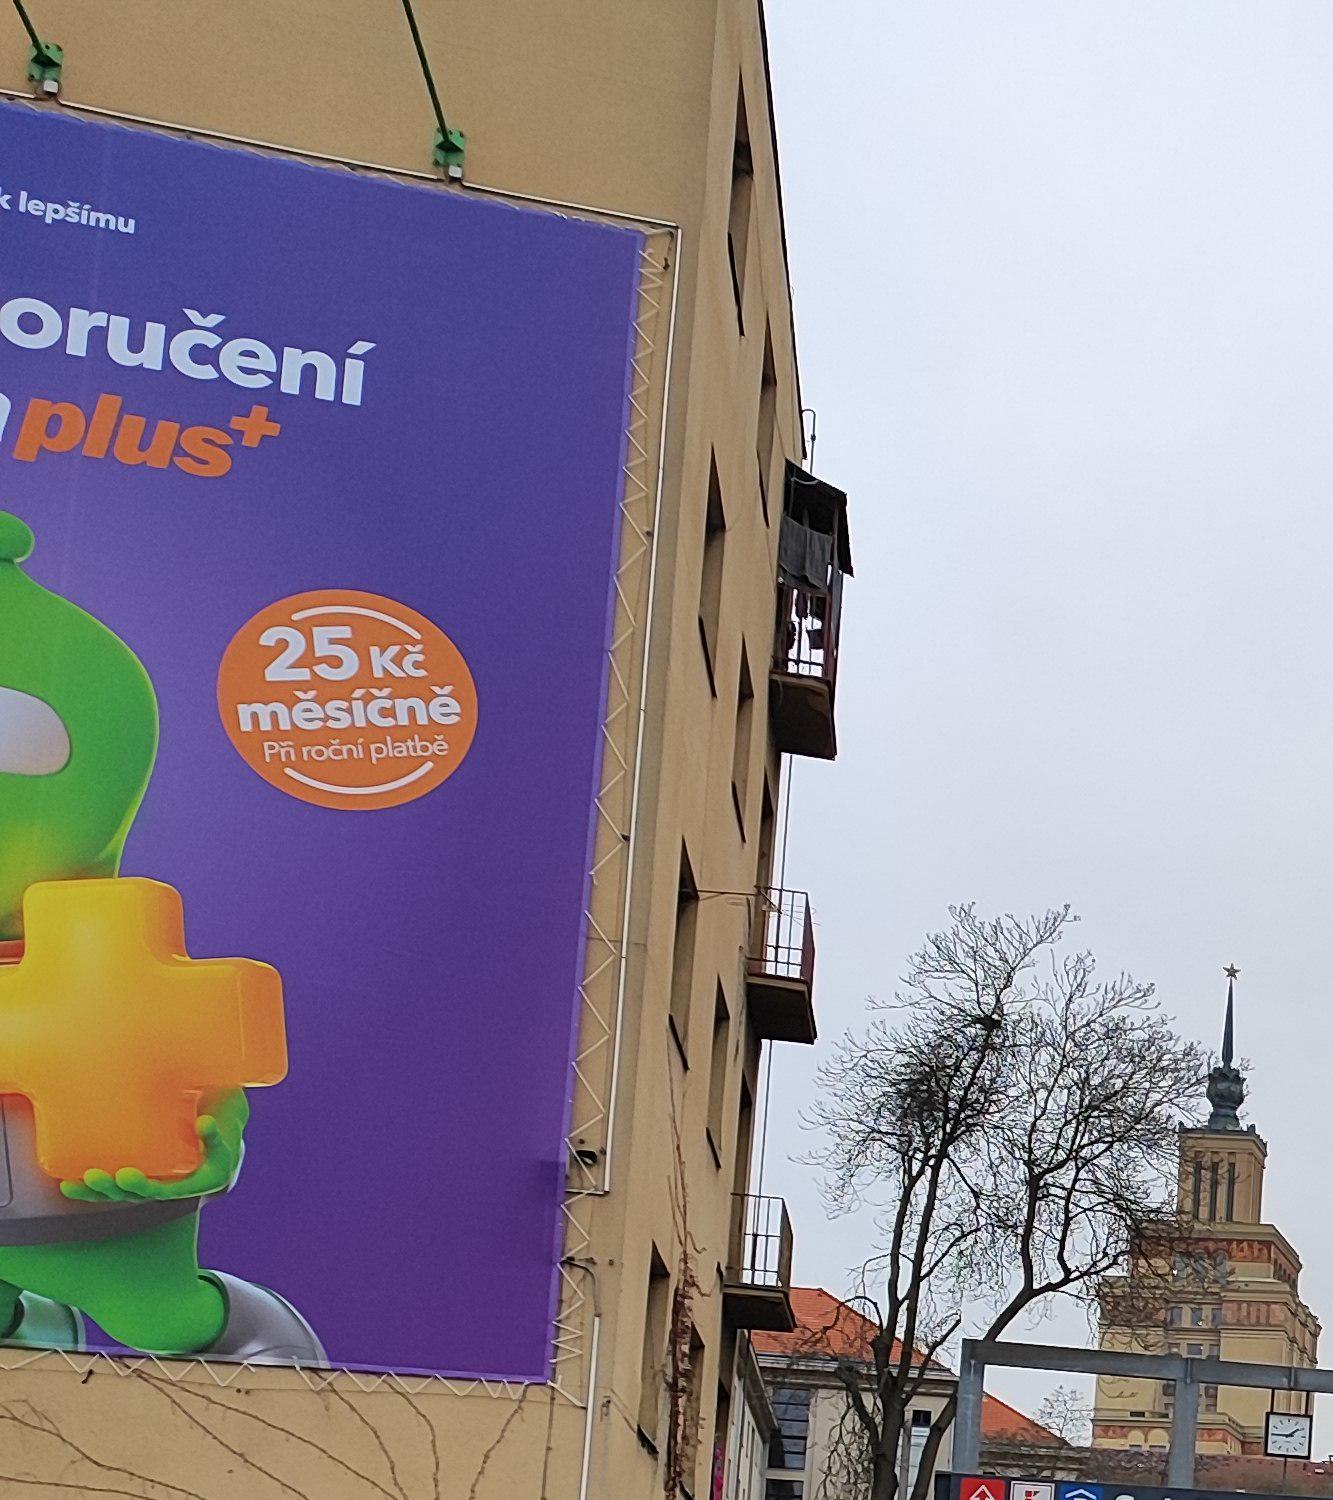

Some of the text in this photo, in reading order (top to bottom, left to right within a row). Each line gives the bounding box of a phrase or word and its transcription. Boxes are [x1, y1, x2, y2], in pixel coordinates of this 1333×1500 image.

[19, 190, 136, 234] lepšímu
[0, 297, 377, 406] oručení
[259, 626, 428, 681] 25 Kč
[237, 685, 461, 732] měsíčně
[263, 734, 448, 764] Při roční platbě
